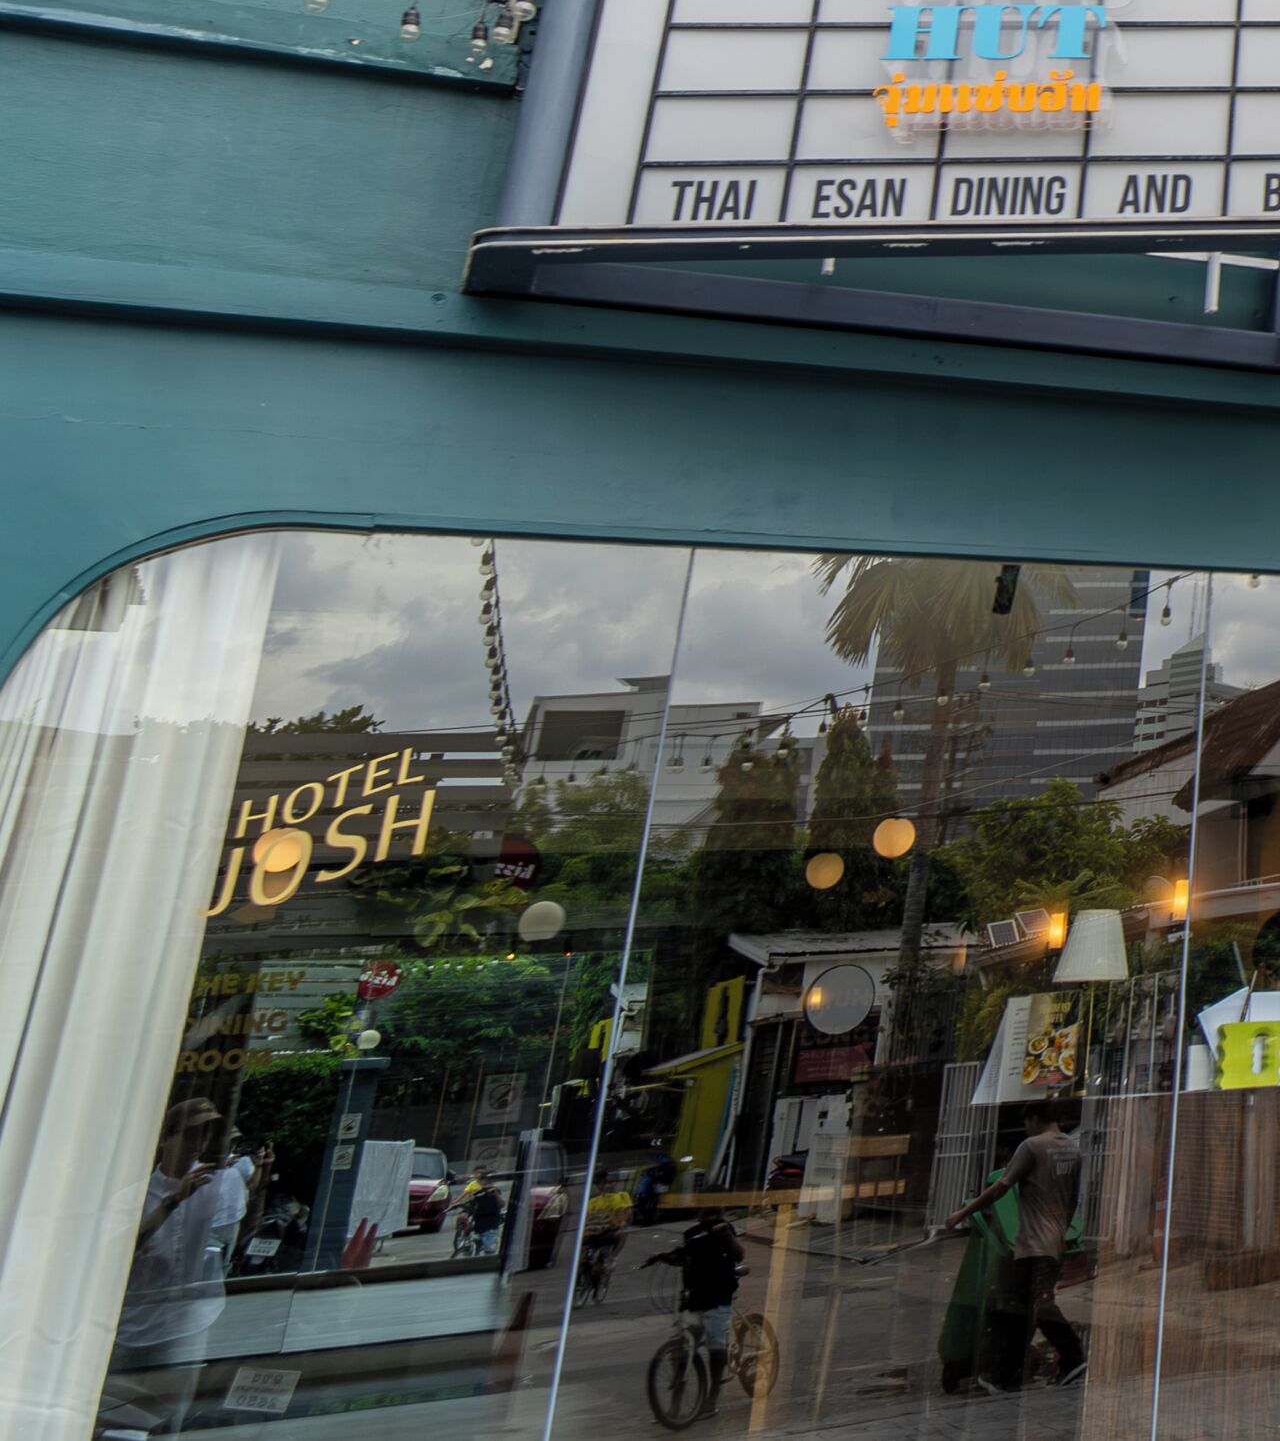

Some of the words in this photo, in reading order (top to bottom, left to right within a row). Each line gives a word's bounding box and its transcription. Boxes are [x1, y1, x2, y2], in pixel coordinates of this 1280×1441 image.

[883, 4, 1107, 61] HUT
[671, 180, 757, 221] THAI
[811, 178, 906, 219] ESAN
[950, 176, 1066, 216] DINING
[1118, 174, 1192, 214] AND
[235, 746, 426, 840] HOTEL
[197, 790, 437, 918] JOSH
[245, 969, 306, 993] KEY
[177, 1047, 273, 1073] ROOM
